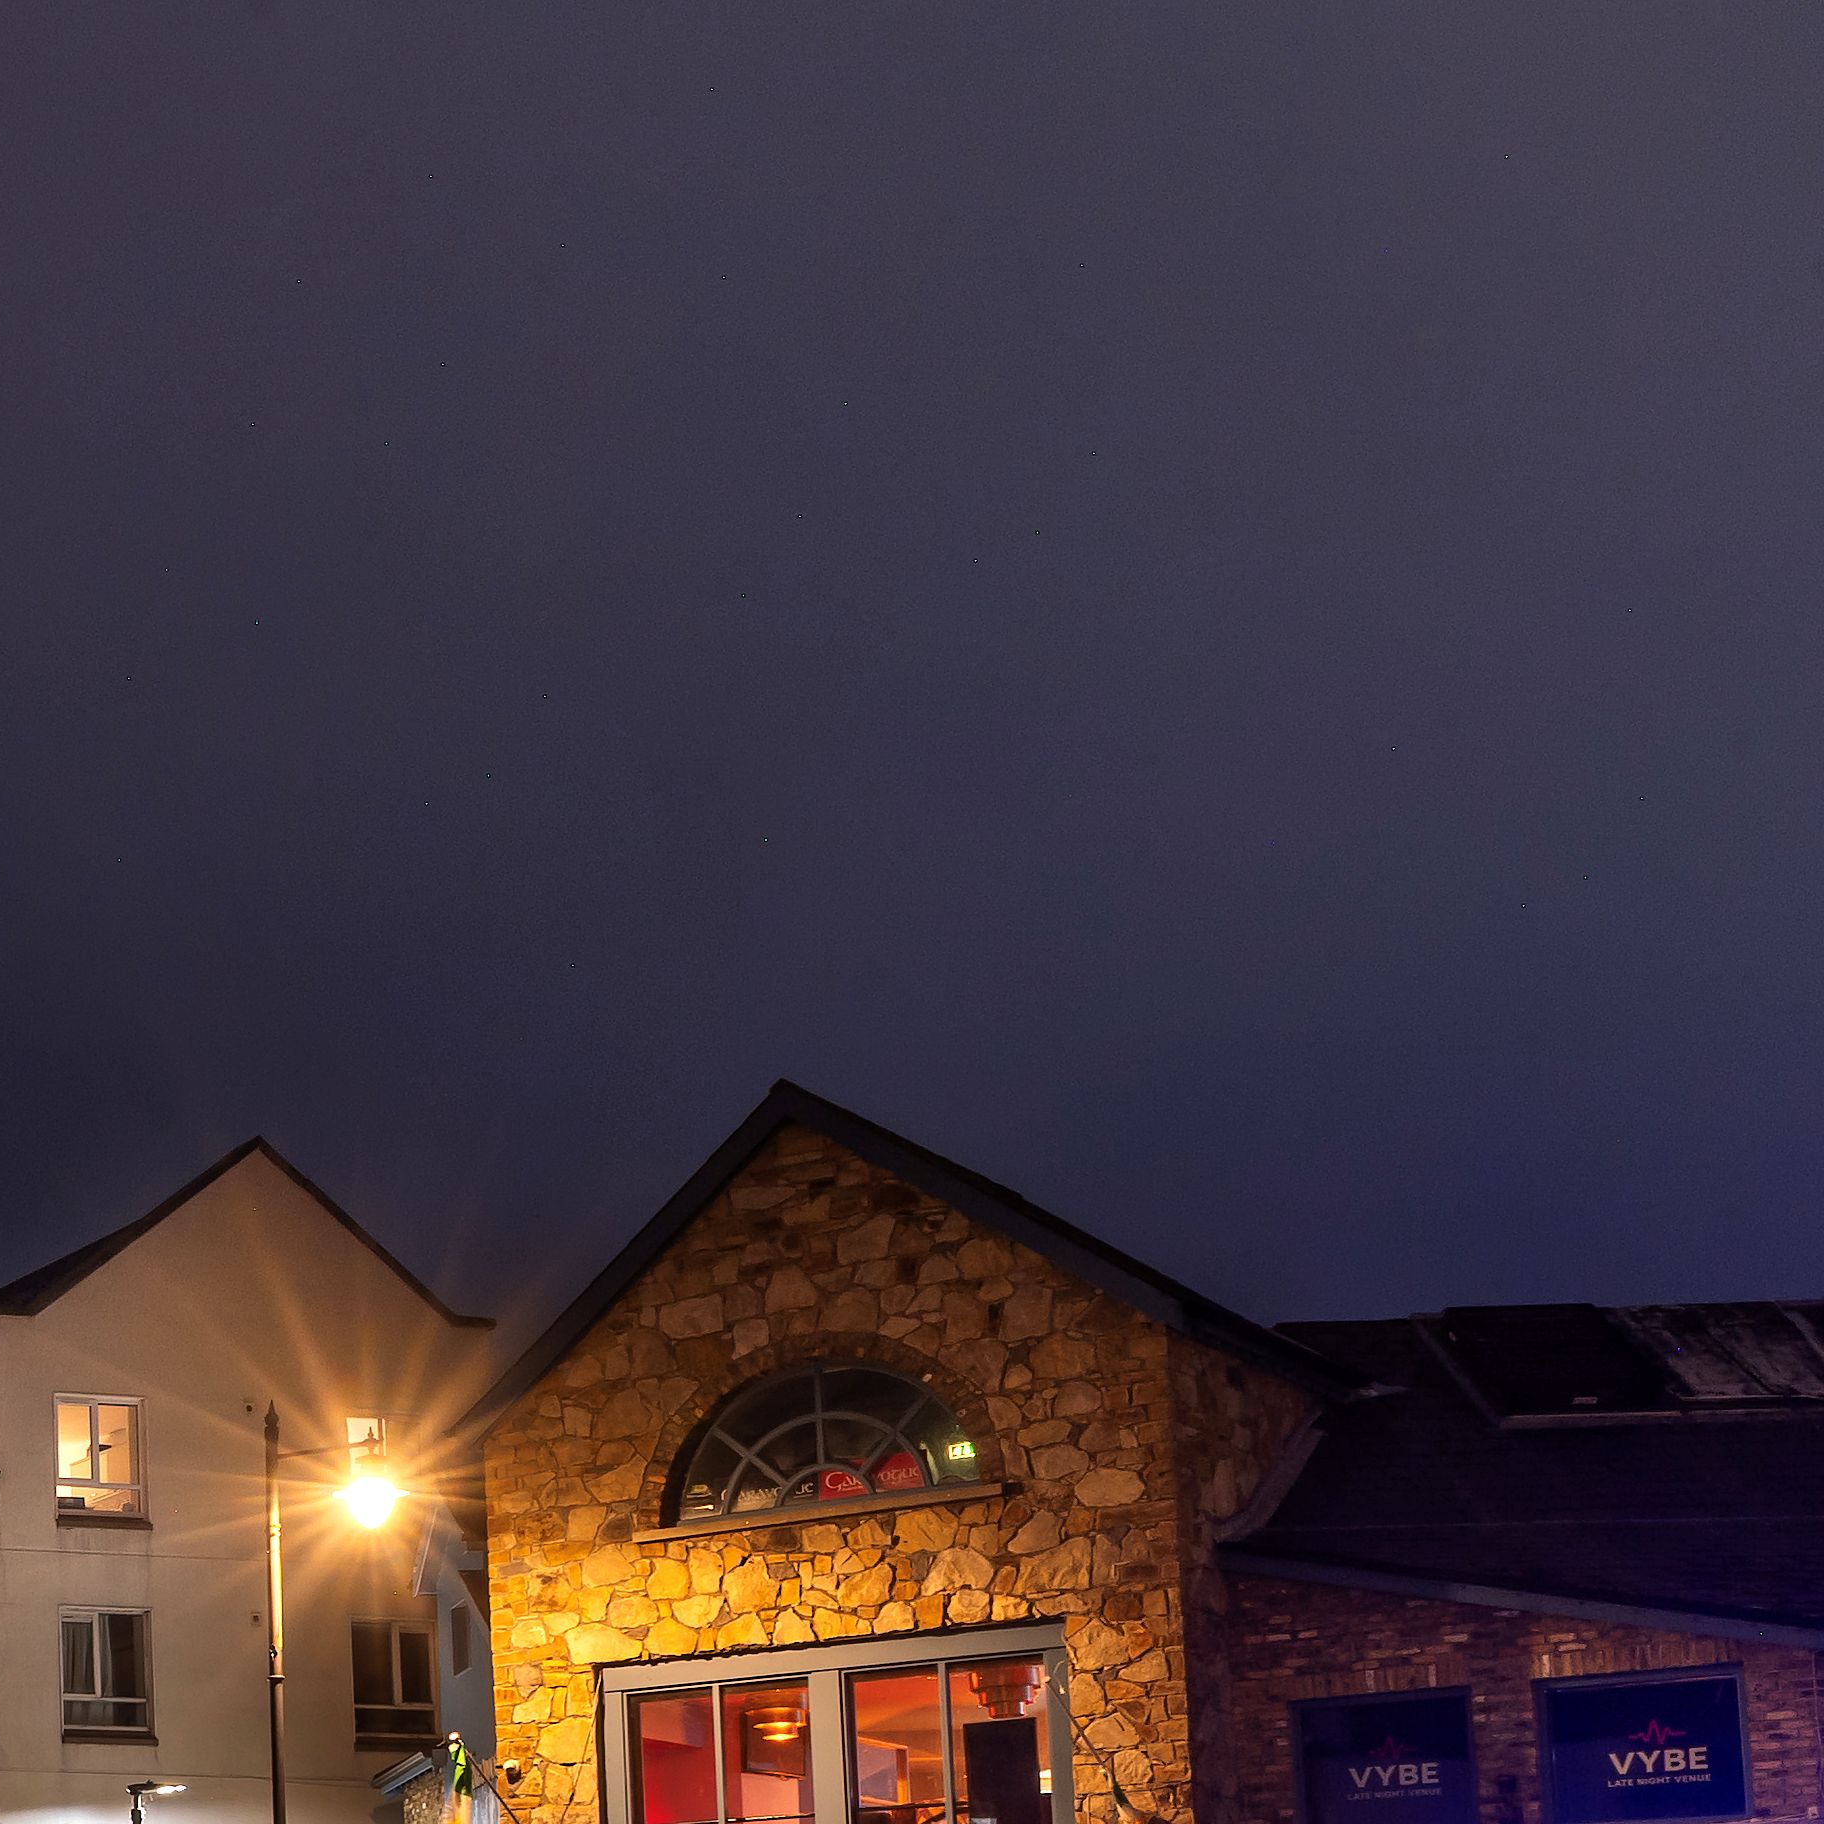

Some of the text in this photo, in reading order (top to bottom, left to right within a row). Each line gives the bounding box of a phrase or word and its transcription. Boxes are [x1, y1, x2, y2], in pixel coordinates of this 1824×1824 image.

[1608, 1747, 1709, 1775] VYBE
[1348, 1762, 1440, 1788] VYBE
[1608, 1774, 1711, 1788] LATE NIGHT VENUE
